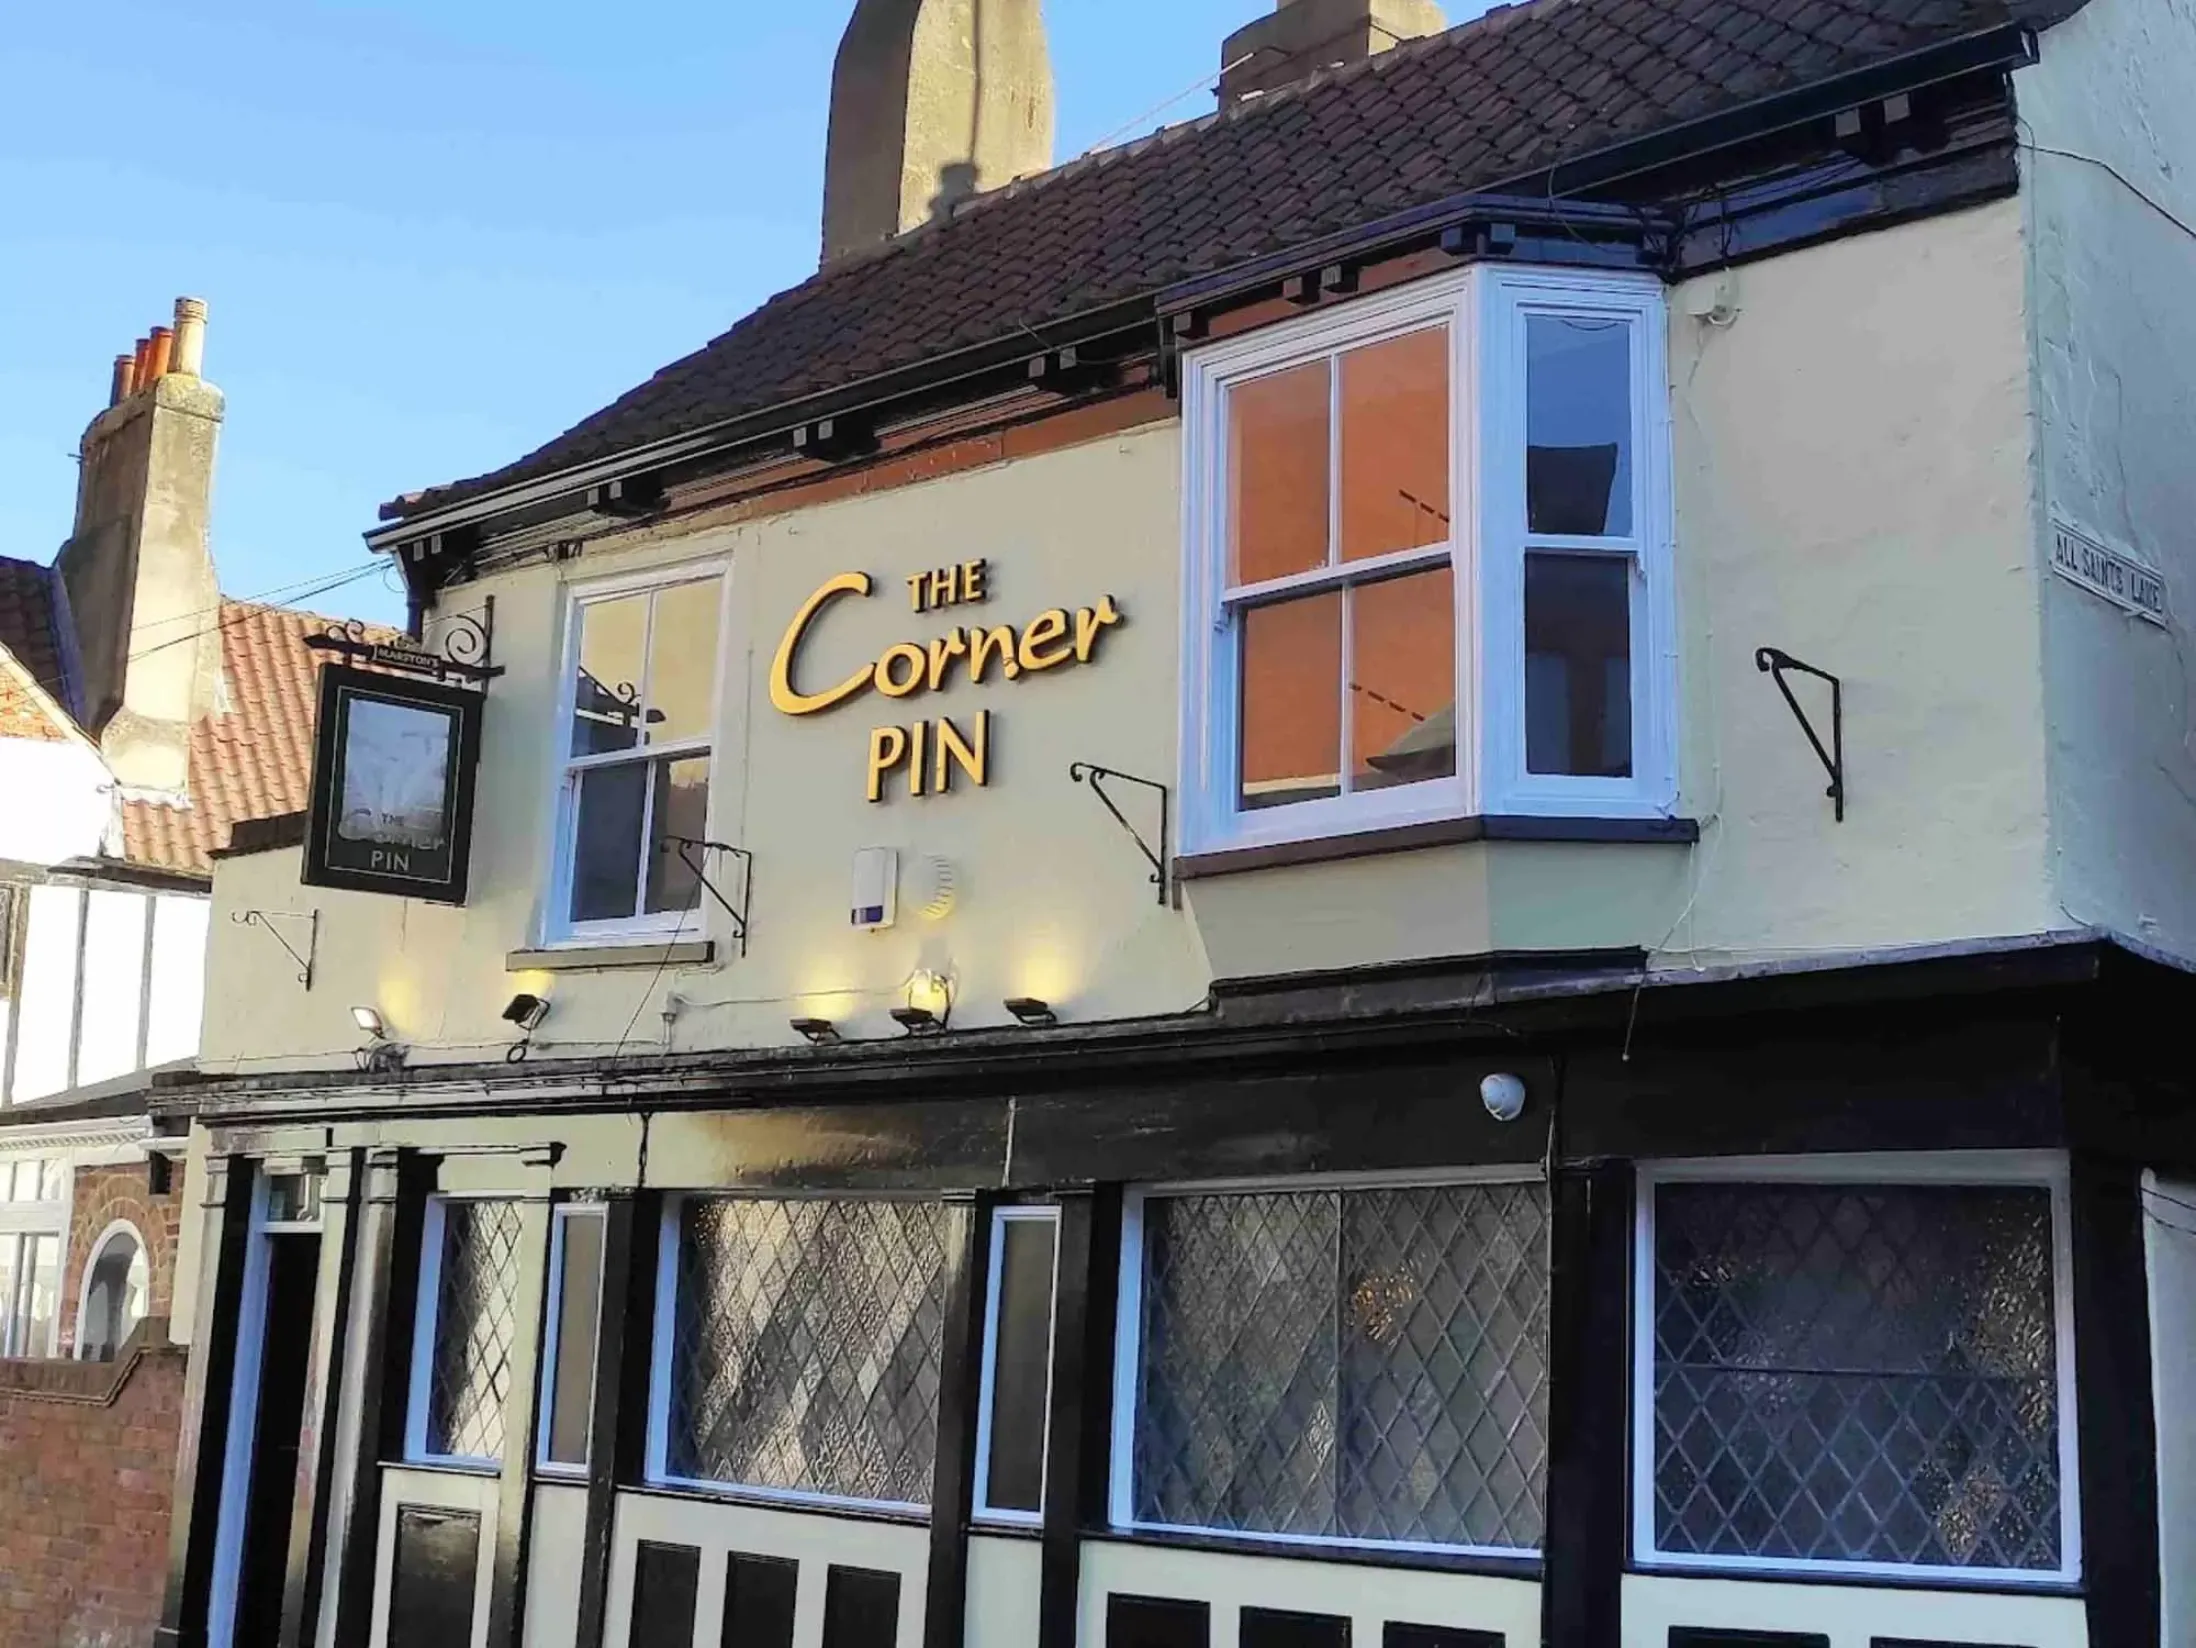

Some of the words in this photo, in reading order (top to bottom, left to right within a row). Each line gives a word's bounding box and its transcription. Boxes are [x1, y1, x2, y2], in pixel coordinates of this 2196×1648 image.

[906, 558, 986, 613] THE
[2055, 533, 2078, 570] ALL
[2082, 547, 2122, 594] SAINTS
[2131, 571, 2162, 613] LANE
[769, 570, 1124, 715] Corner
[867, 709, 989, 803] PIN
[371, 850, 409, 871] PIN
